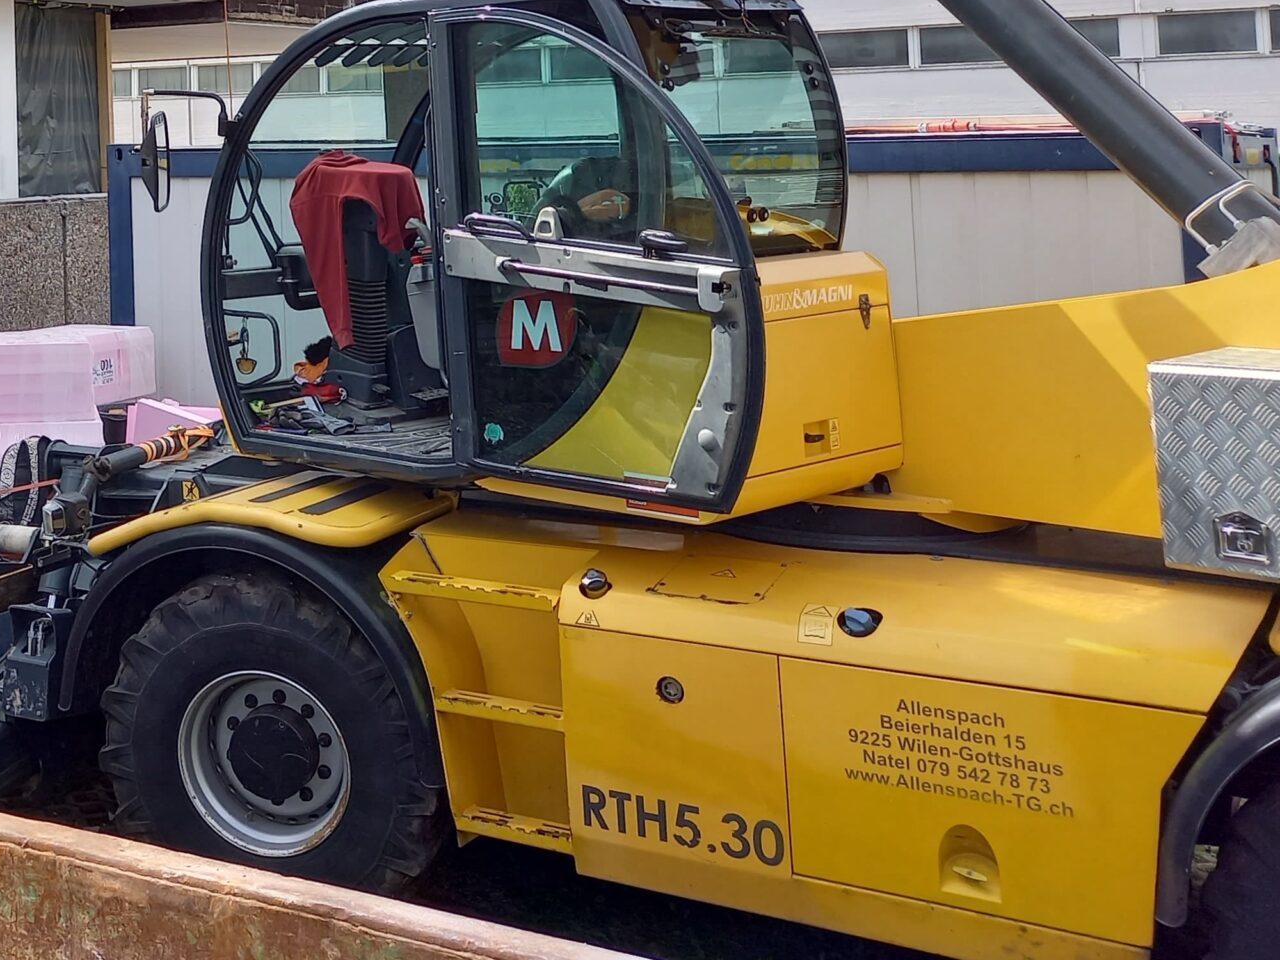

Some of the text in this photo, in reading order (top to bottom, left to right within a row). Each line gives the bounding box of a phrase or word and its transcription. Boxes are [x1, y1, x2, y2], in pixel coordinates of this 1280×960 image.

[510, 298, 563, 353] M
[880, 714, 1026, 751] Beierhalden 15
[896, 698, 1006, 728] Allenspach
[848, 728, 1064, 777] 9225 Wilen-Gottshaus
[862, 748, 1051, 794] Natel 079 542 78 73
[844, 767, 1074, 818] www.Allenspach-TG.ch
[581, 784, 785, 867] RTH5.30
